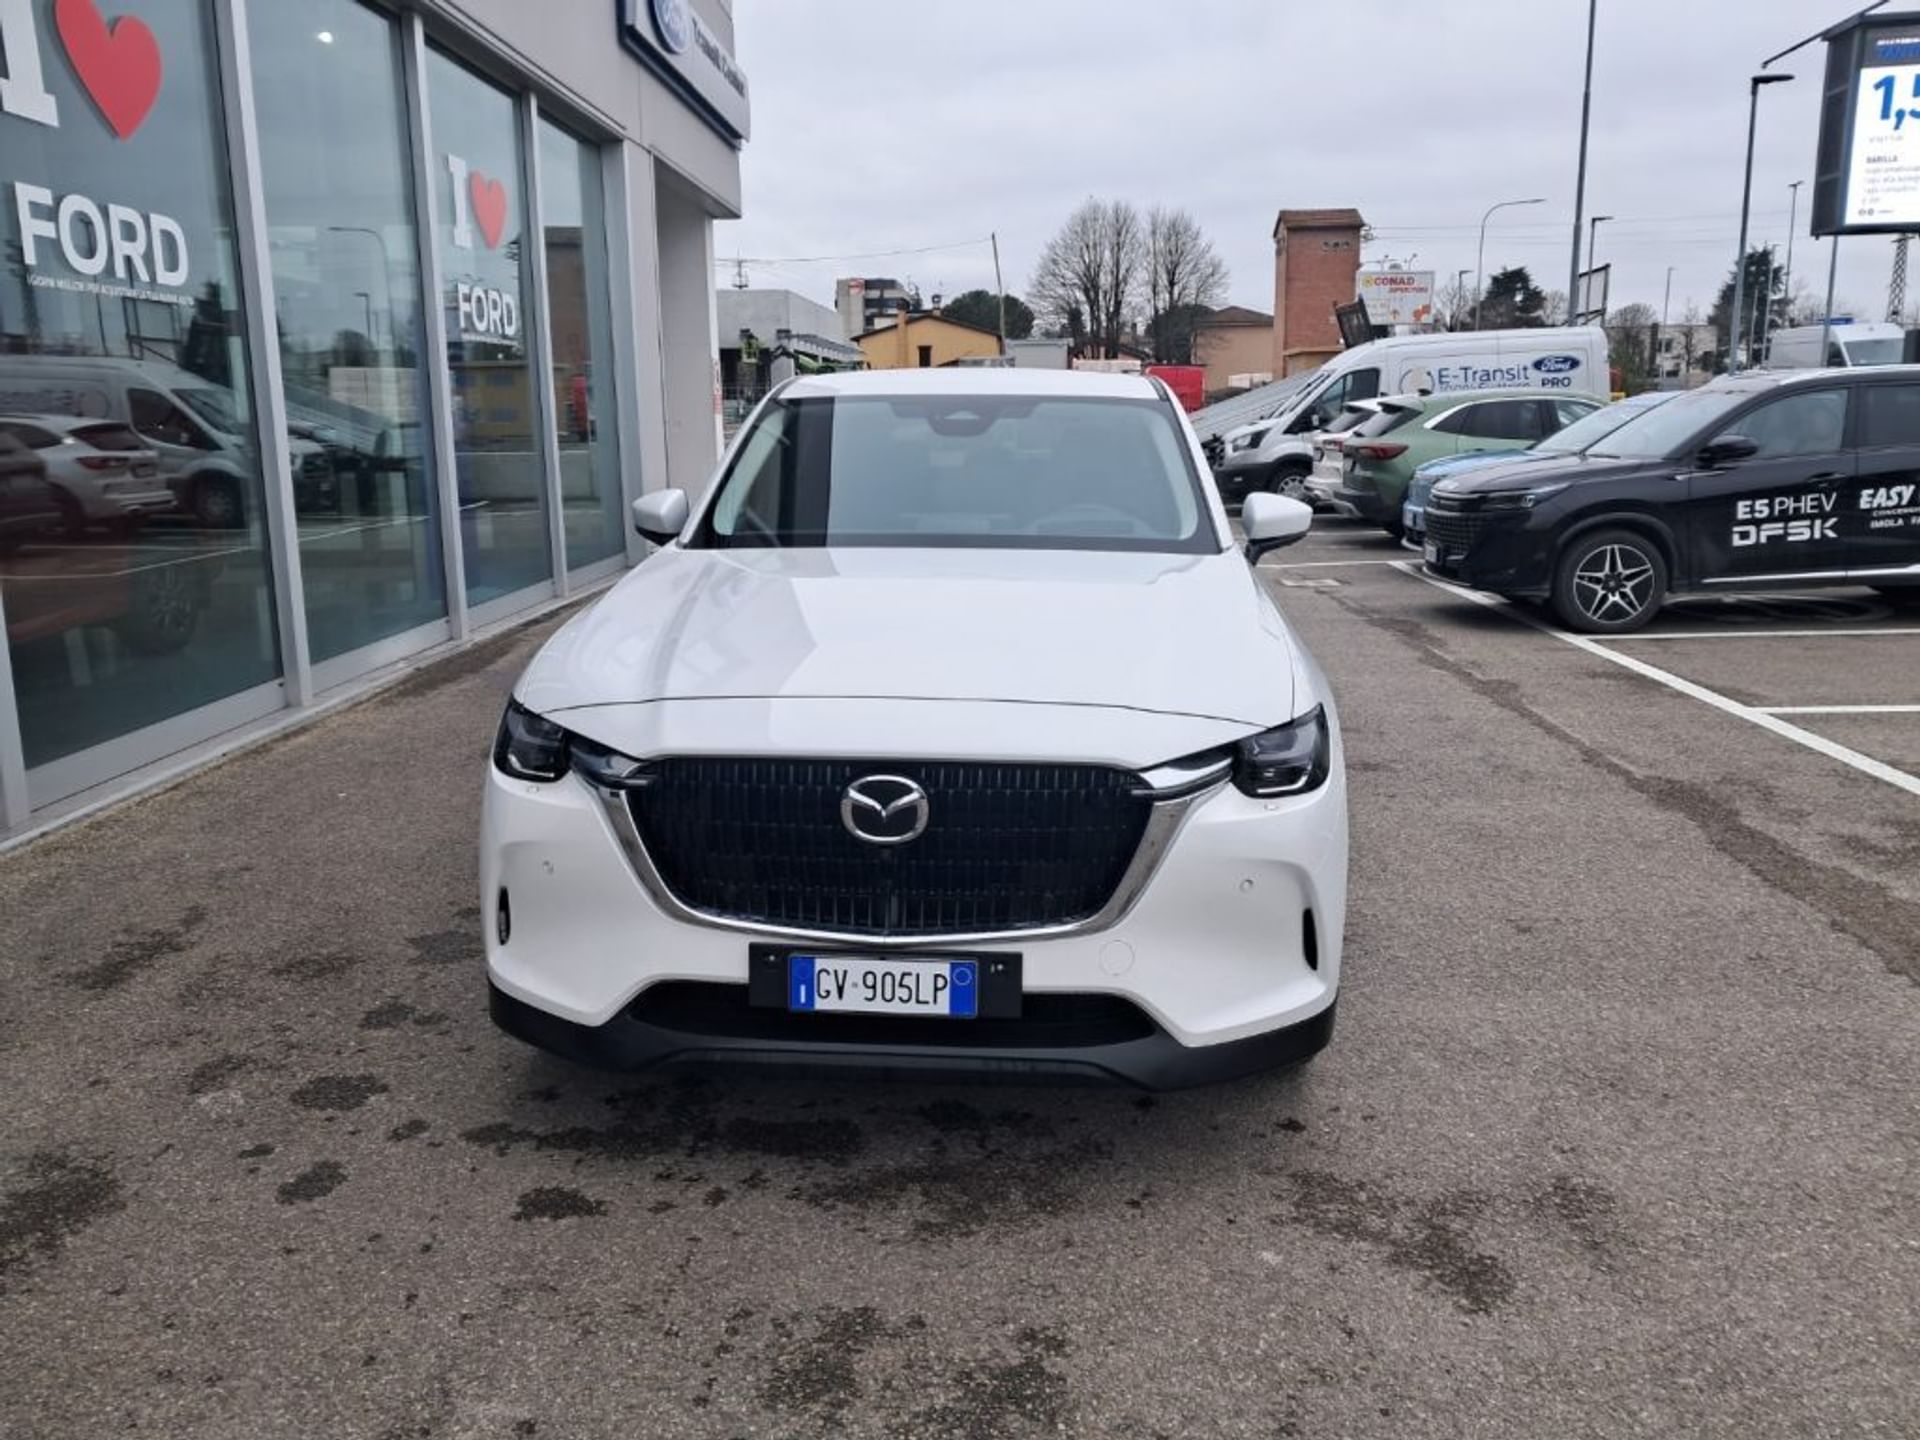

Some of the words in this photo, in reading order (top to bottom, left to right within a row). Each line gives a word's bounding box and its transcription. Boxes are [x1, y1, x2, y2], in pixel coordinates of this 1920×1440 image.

[448, 154, 473, 248] I
[14, 181, 189, 287] FORD
[1374, 276, 1415, 286] CONAD
[457, 282, 516, 336] FORD
[1438, 364, 1530, 385] E-Transit
[1541, 377, 1571, 388] PRO
[1736, 498, 1770, 520] E5
[1774, 492, 1837, 517] PHEV
[1859, 484, 1916, 509] EASY
[1732, 517, 1838, 547] DFSK
[1870, 518, 1904, 529] IMOLA
[817, 968, 848, 1000] GV
[862, 971, 949, 1005] 905LP
